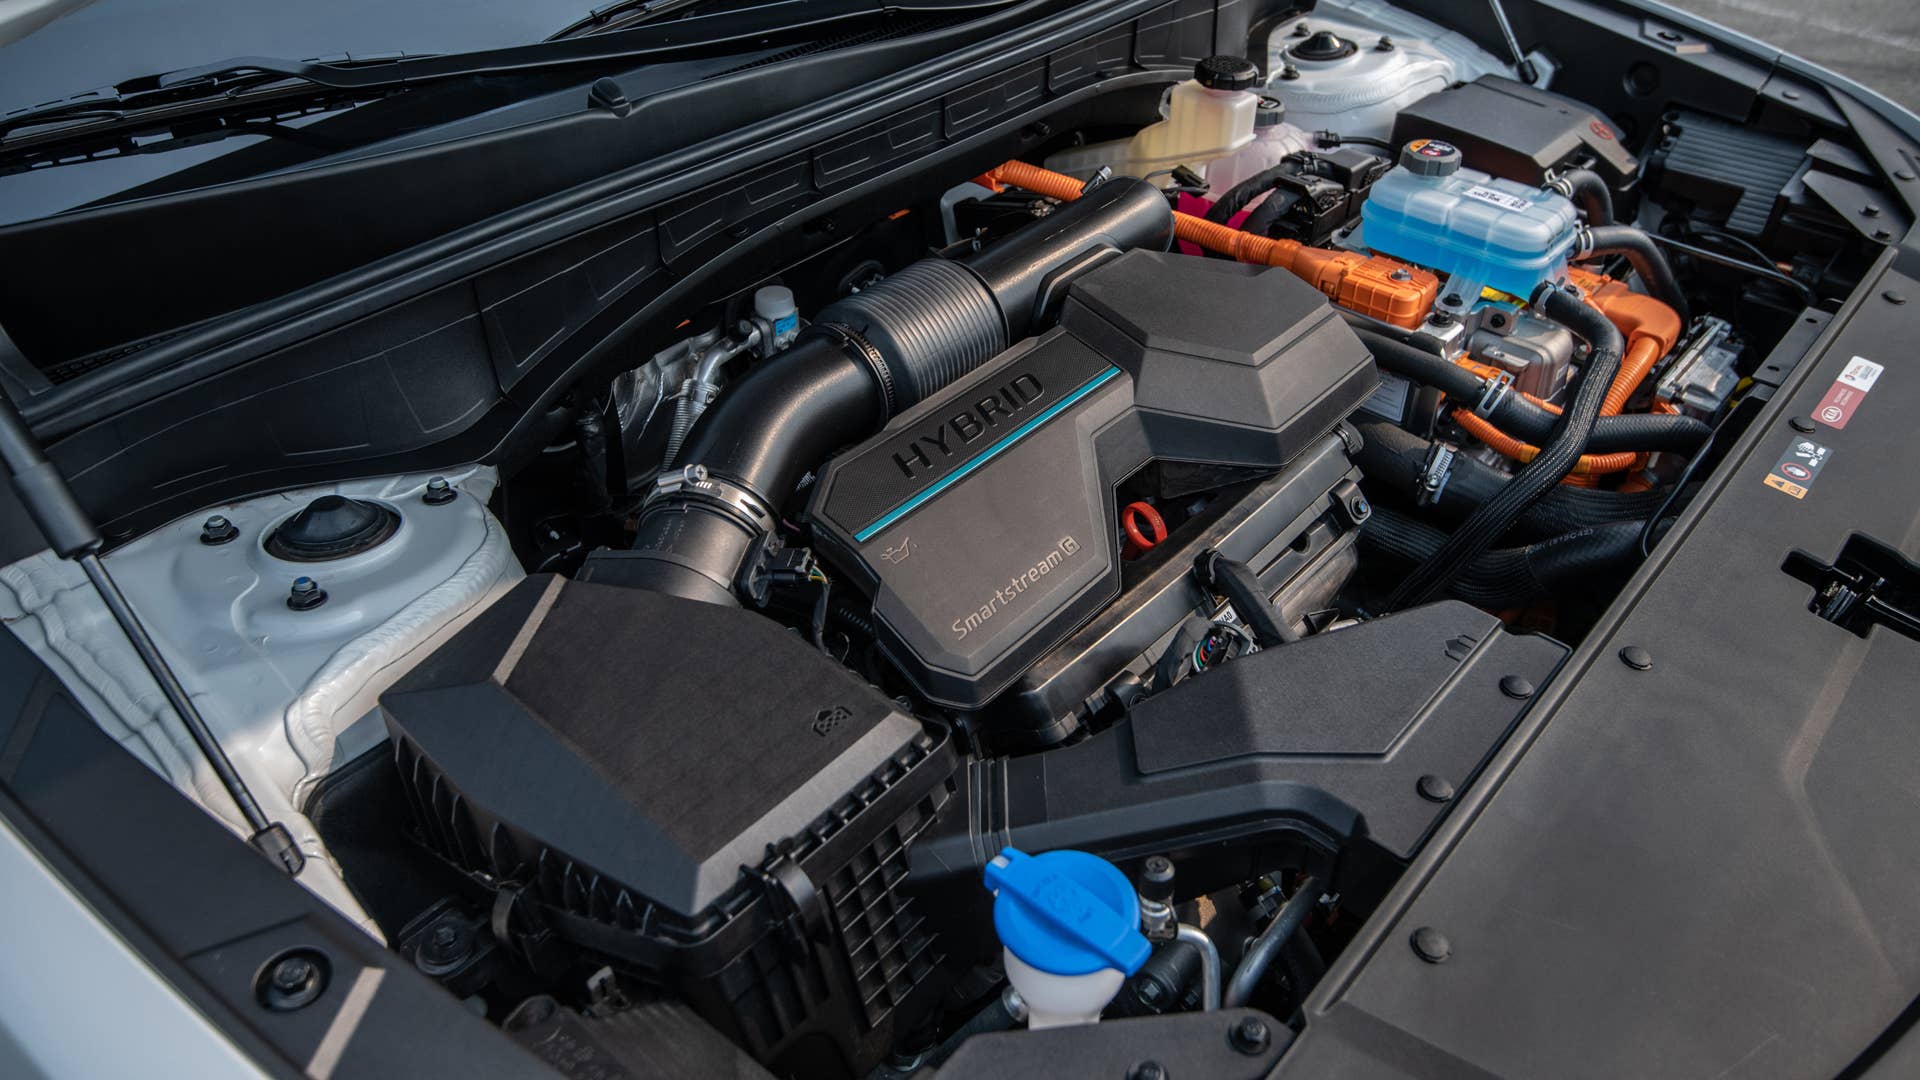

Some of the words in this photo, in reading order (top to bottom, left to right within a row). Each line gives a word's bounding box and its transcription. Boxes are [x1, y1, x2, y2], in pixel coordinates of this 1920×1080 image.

[892, 373, 1045, 479] HYBRID
[952, 550, 1064, 641] Smartstream
[1059, 535, 1082, 556] G
